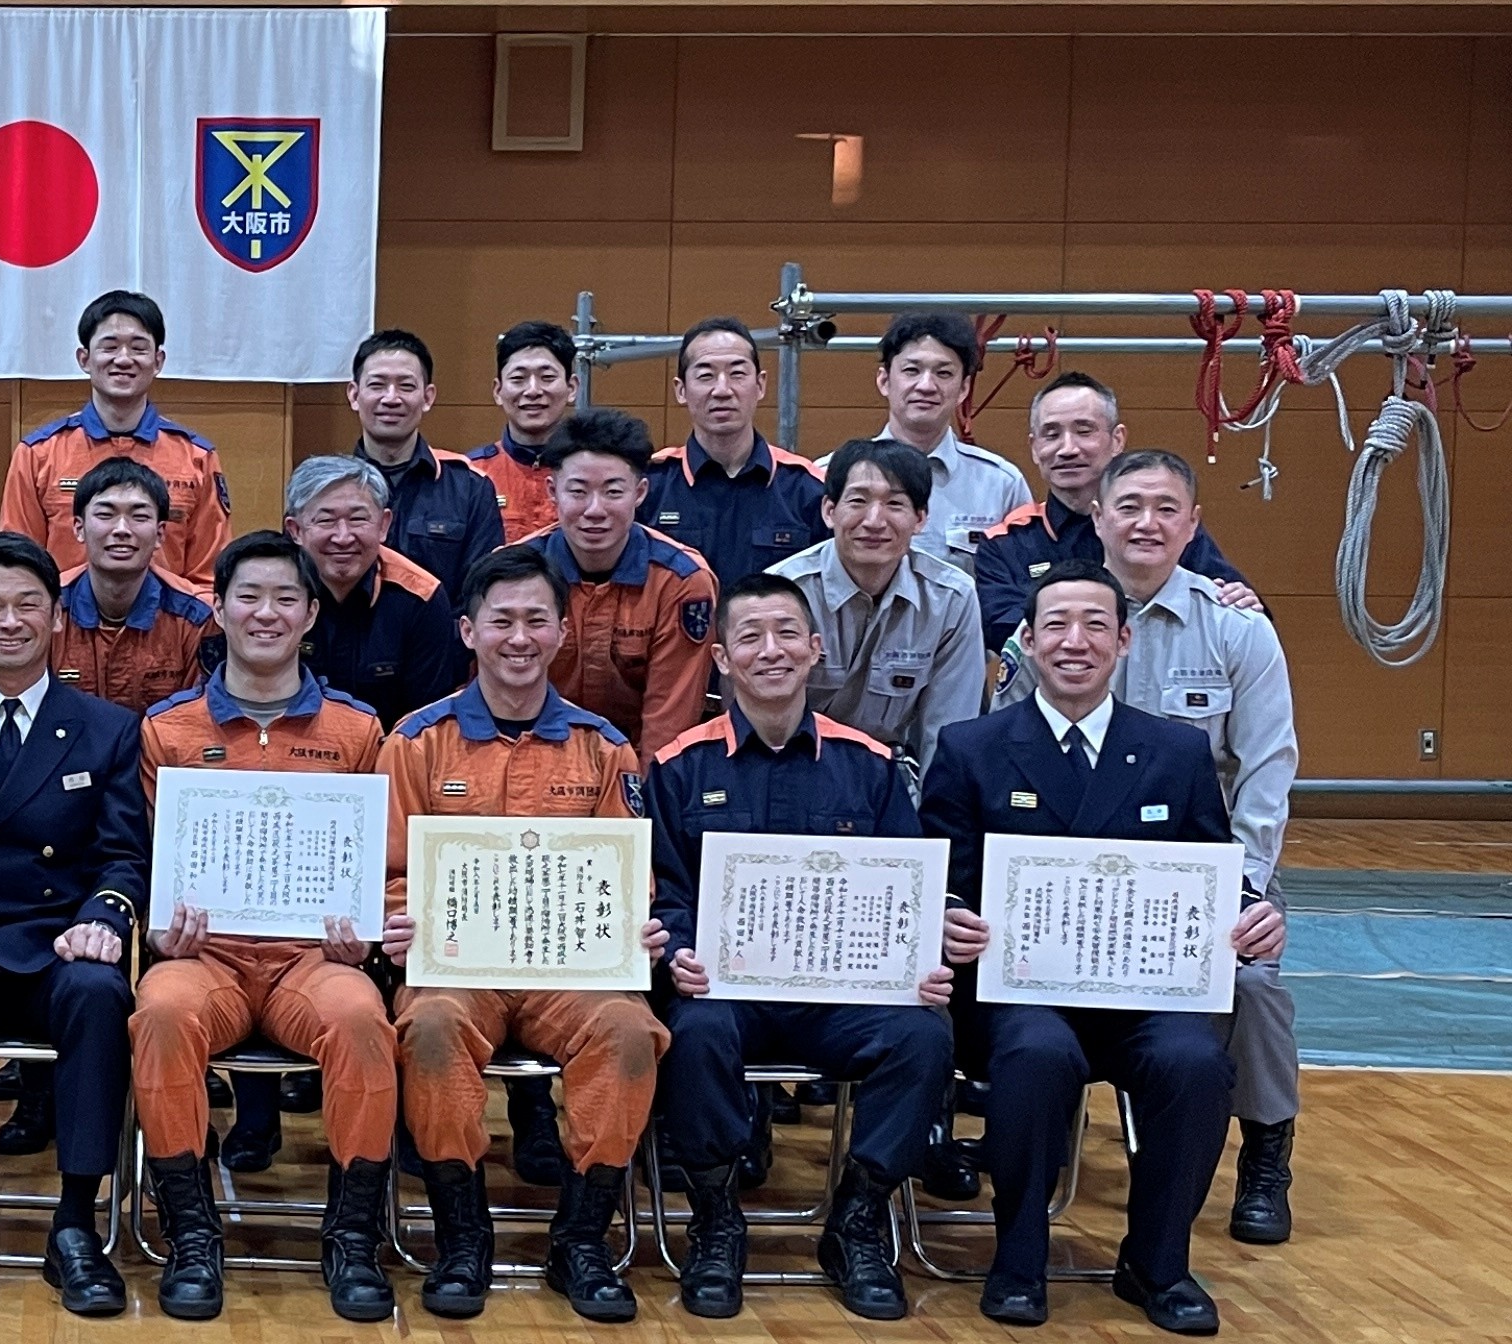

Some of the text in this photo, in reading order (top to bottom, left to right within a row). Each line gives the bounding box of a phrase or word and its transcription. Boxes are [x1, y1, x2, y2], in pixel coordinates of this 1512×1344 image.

[221, 211, 291, 235] 大阪市
[340, 835, 353, 878] 表彰状
[595, 879, 612, 939] 表彰状
[895, 900, 910, 944] 表彰状
[1183, 905, 1200, 958] 表彰状
